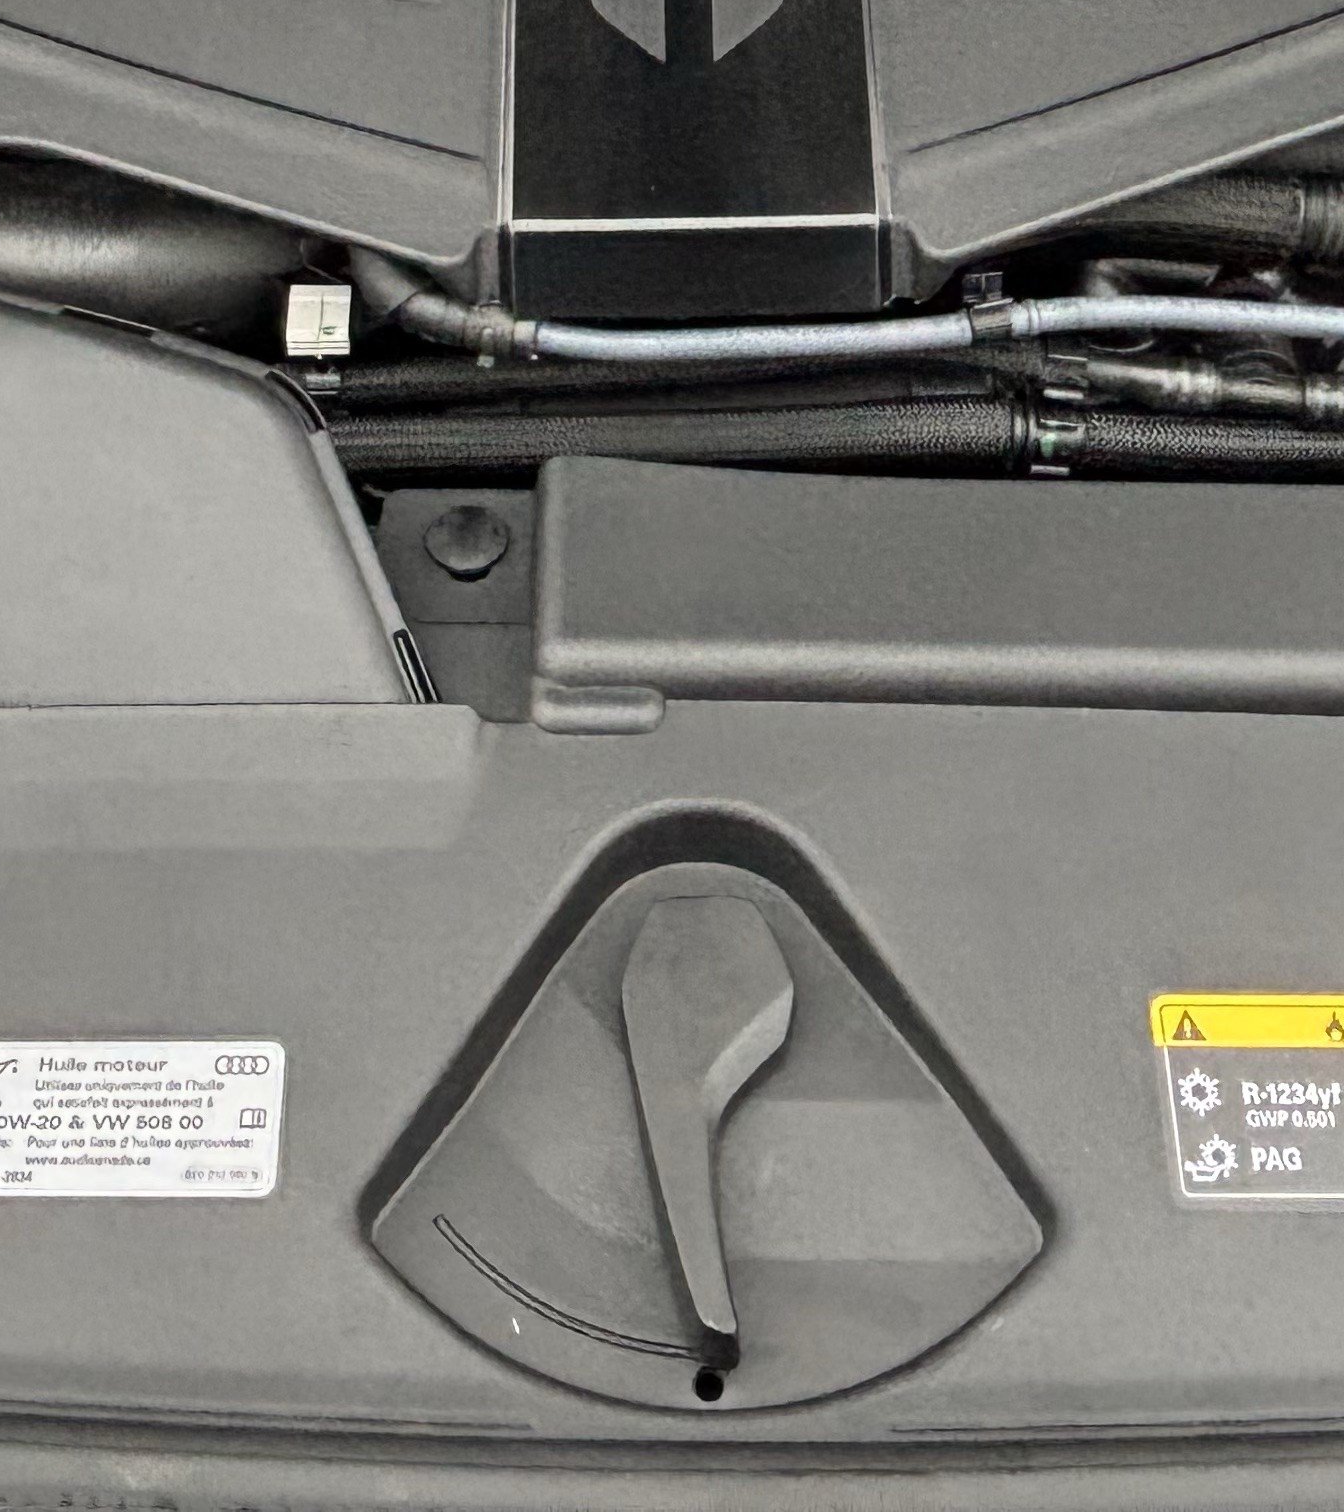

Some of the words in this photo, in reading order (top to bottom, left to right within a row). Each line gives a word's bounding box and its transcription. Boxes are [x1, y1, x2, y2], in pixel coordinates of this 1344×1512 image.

[94, 1059, 168, 1072] moteur
[68, 1116, 85, 1129] &
[93, 1115, 130, 1129] VW
[179, 1116, 204, 1129] 00
[1246, 1110, 1288, 1128] GWP
[1251, 1146, 1302, 1171] PAG
